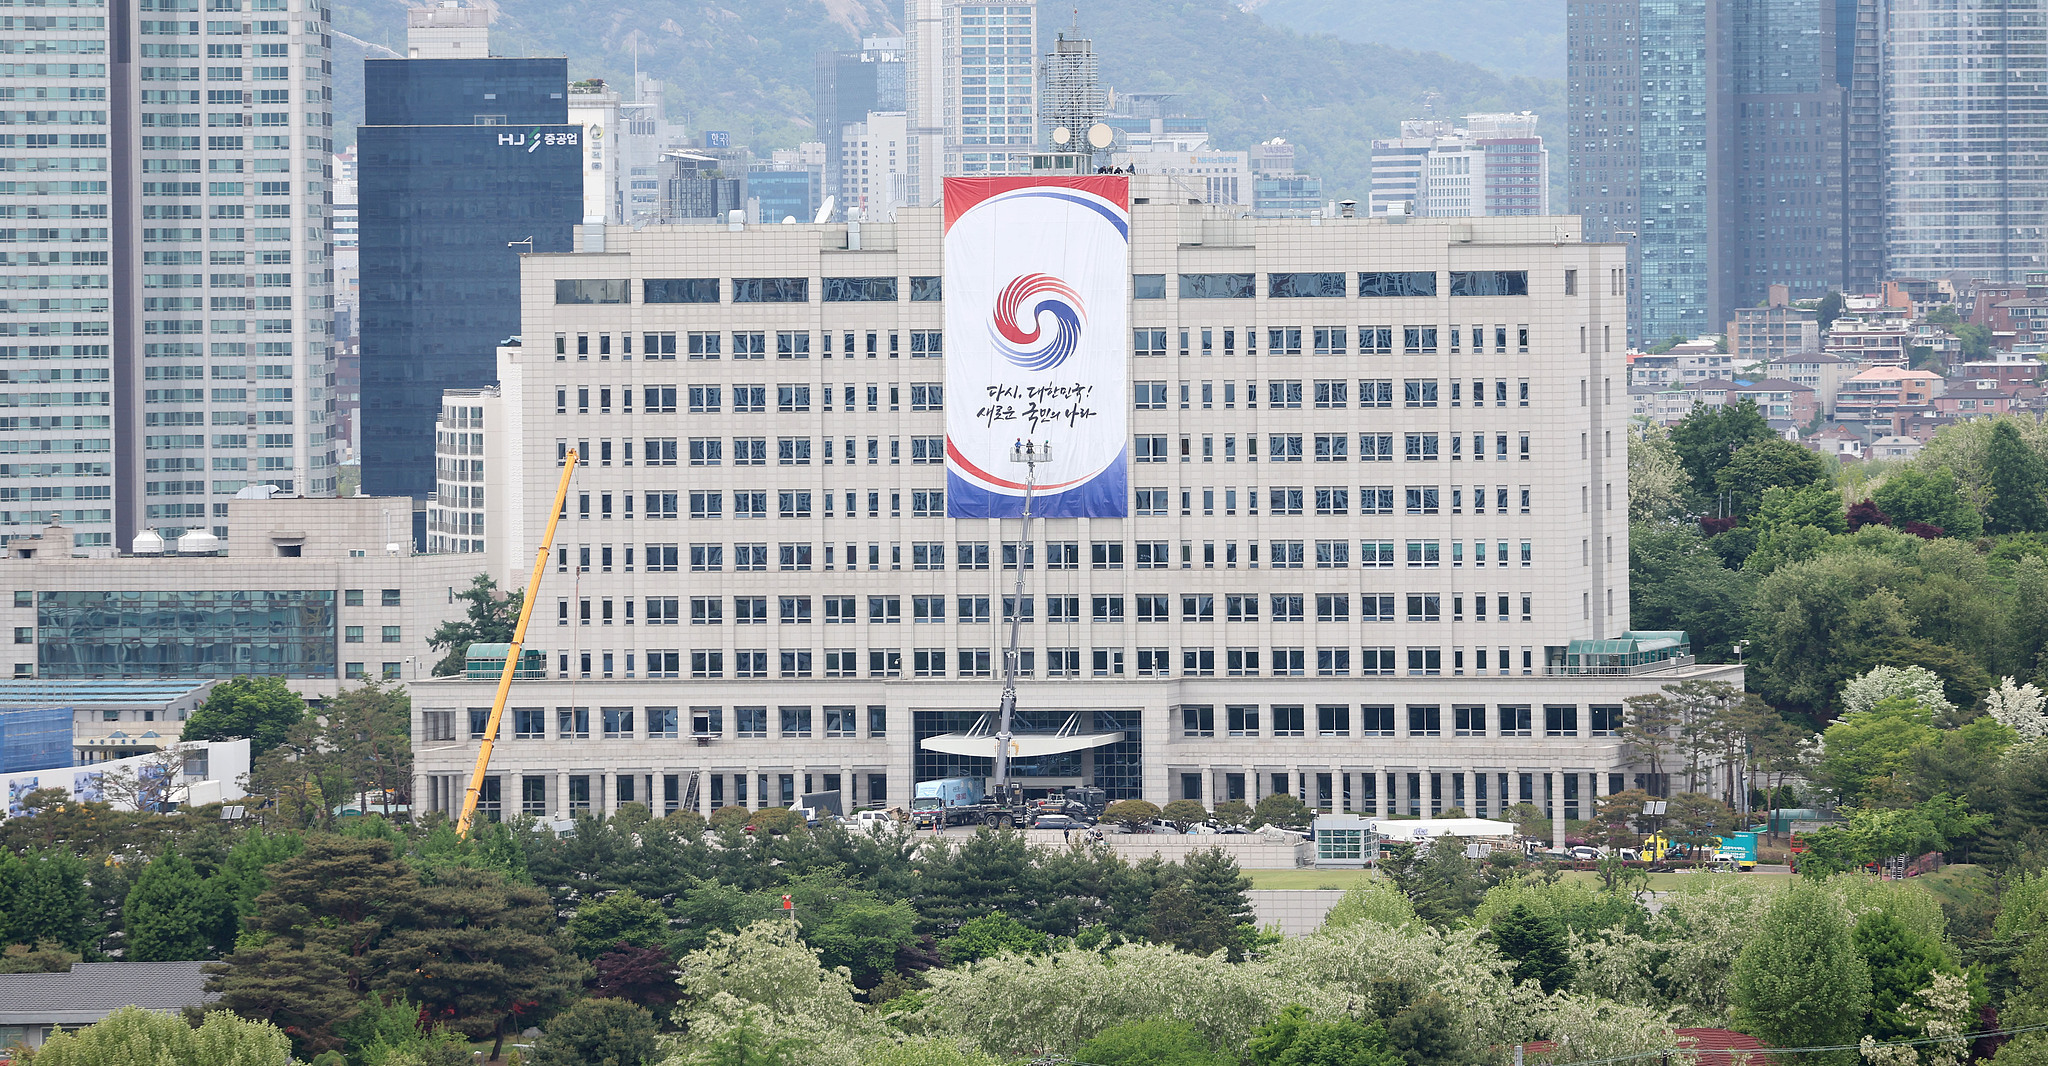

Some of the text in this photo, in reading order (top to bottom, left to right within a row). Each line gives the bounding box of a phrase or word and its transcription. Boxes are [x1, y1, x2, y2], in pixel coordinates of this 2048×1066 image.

[498, 132, 578, 146] HJ 중공업
[986, 381, 1093, 403] 다시, 대한민국!
[976, 401, 1097, 434] 새로운 국민의 나라
